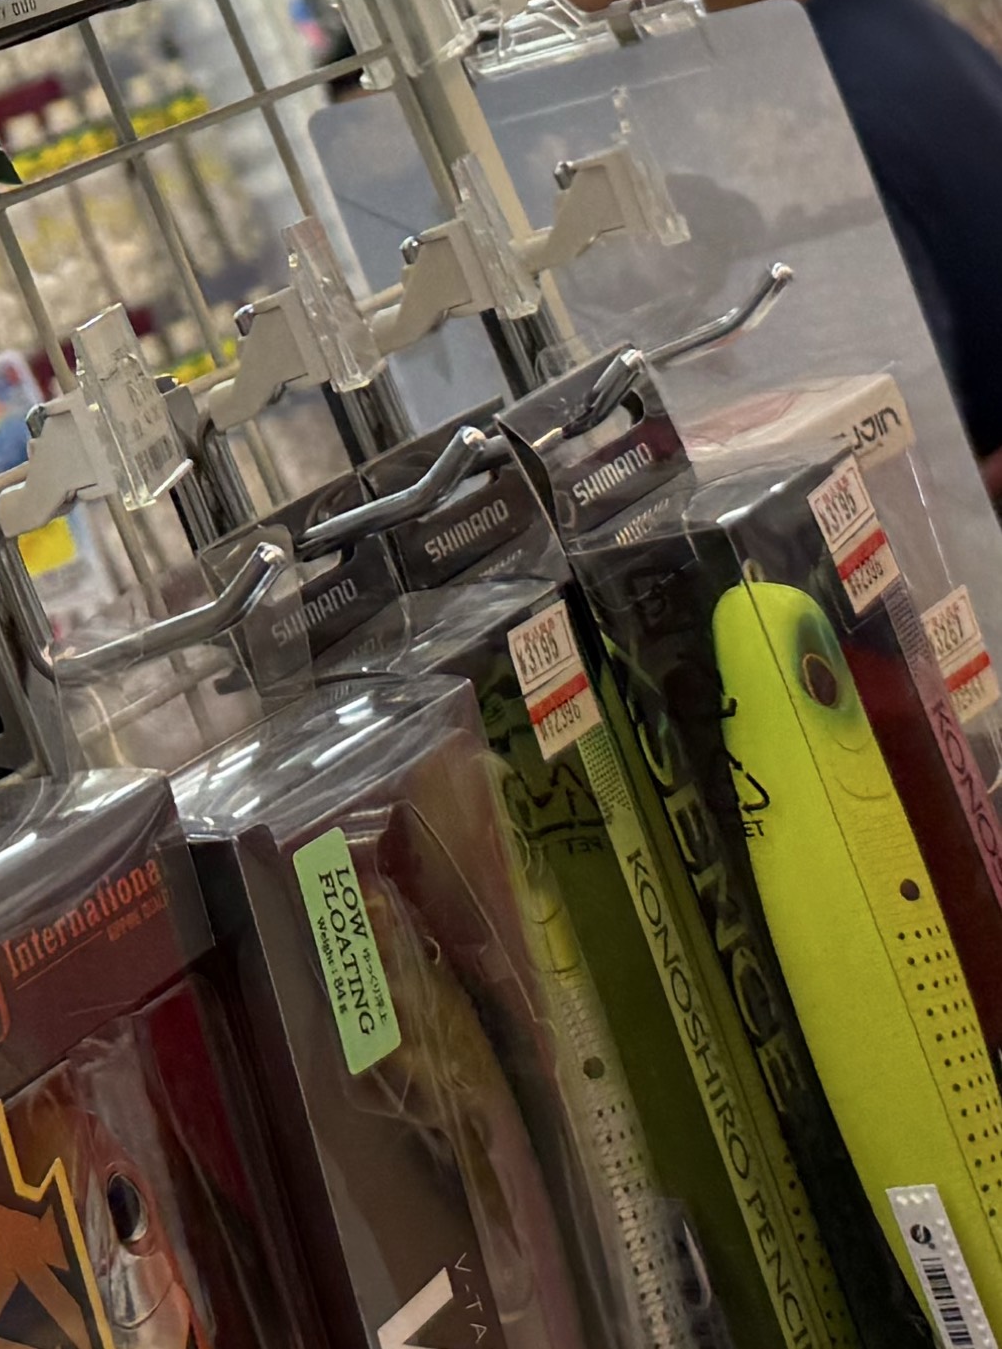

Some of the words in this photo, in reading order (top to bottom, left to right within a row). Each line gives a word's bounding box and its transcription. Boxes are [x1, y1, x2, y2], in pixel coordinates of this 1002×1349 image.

[572, 442, 654, 507] SHIMANO
[424, 498, 509, 563] SHIMANO
[271, 578, 359, 647] SHIMANO
[335, 866, 369, 939] LOW
[318, 870, 375, 1035] FLOATING
[625, 849, 750, 1179] KONOSHIRO
[745, 1190, 813, 1349] PENCI
